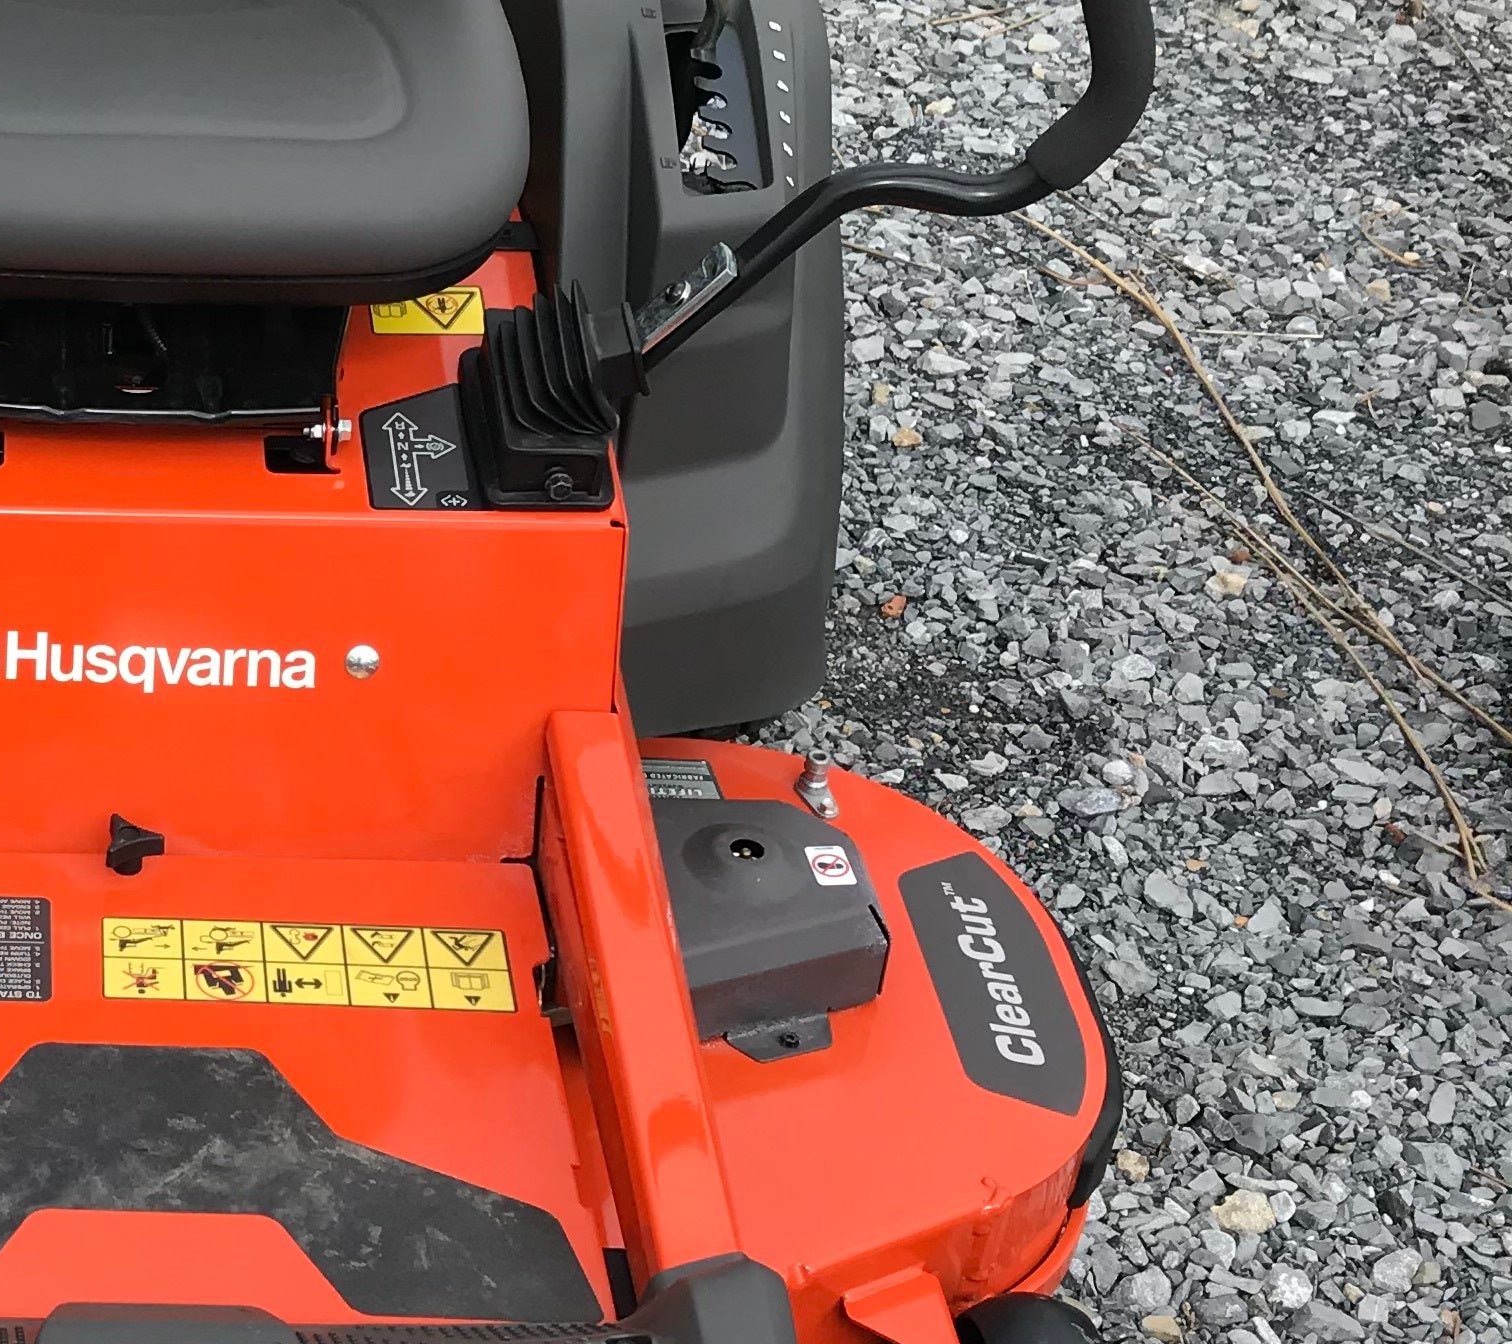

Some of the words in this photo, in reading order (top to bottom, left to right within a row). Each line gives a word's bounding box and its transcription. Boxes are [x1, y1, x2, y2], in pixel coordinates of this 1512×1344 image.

[6, 631, 316, 693] Husqvarna
[650, 787, 703, 796] LIFETI
[9, 931, 42, 939] ONCE
[26, 991, 42, 999] TO
